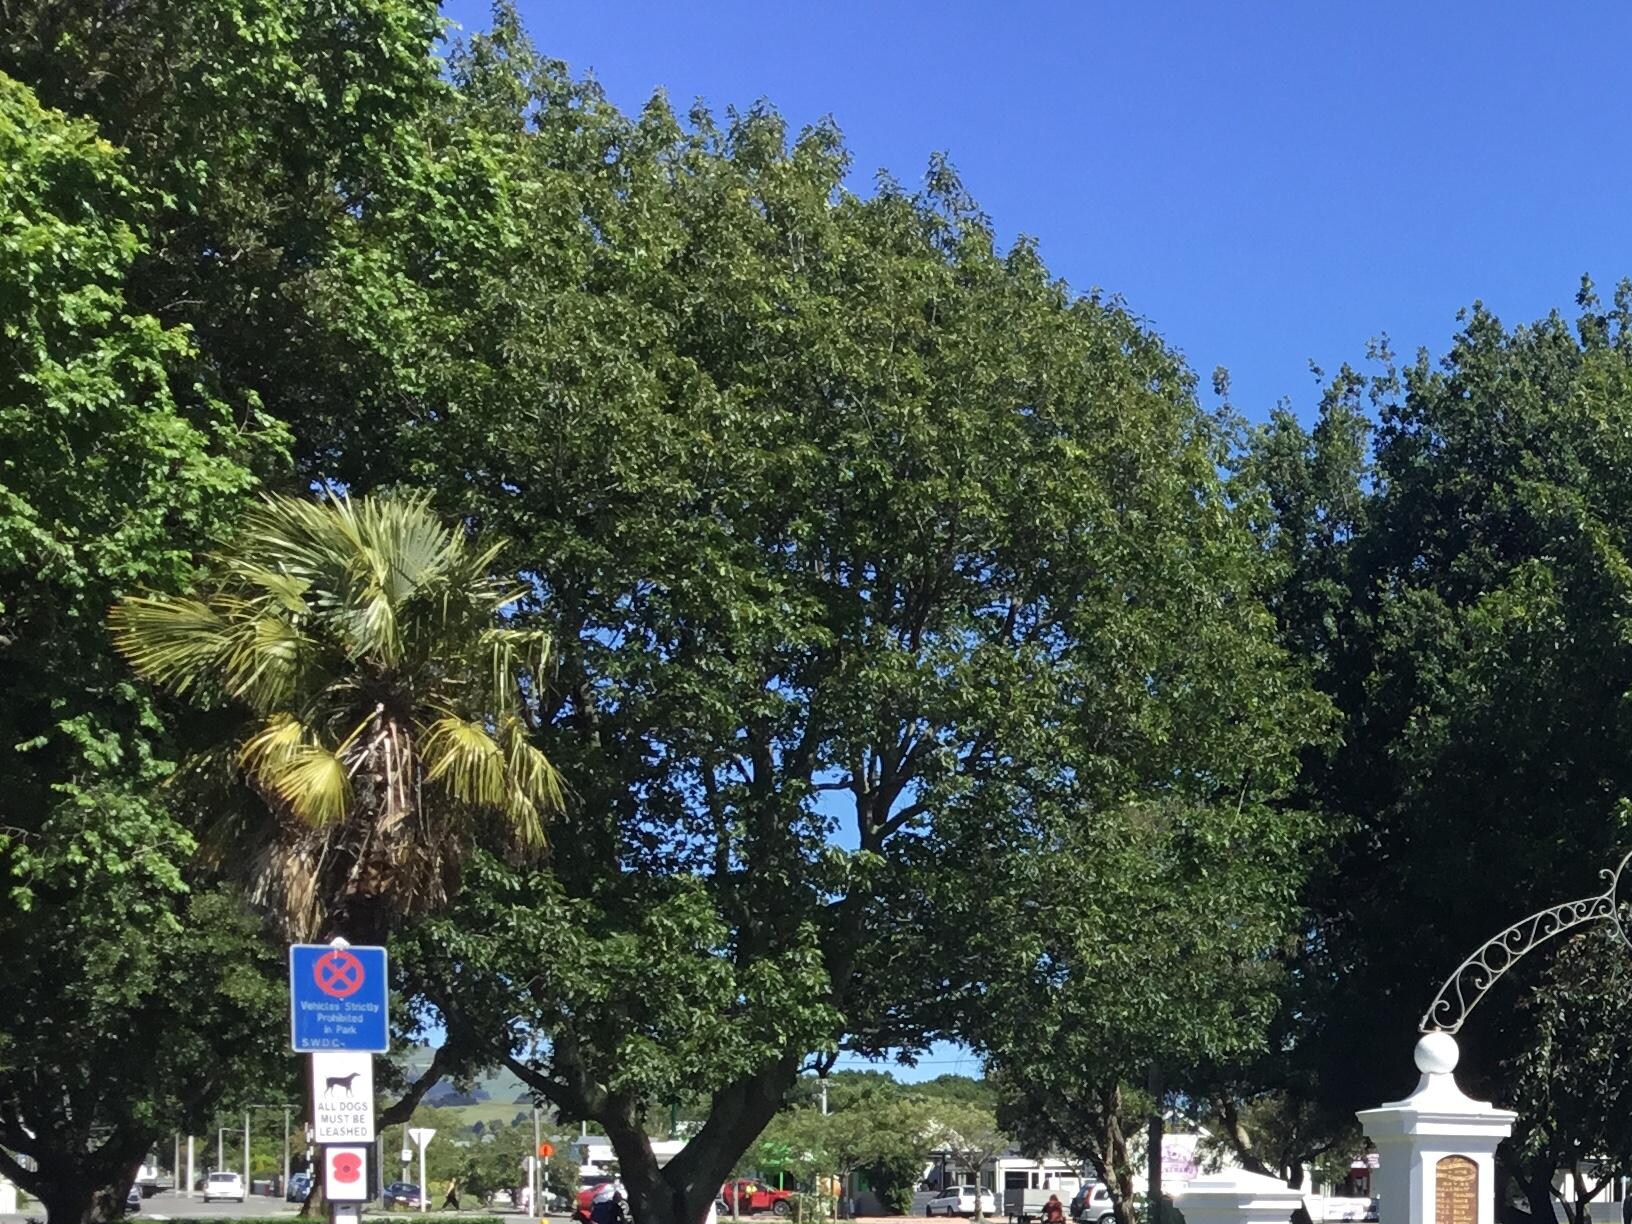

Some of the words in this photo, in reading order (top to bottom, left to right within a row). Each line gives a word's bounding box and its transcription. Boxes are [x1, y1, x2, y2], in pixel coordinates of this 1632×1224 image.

[301, 1001, 340, 1011] Vehicles
[345, 1001, 379, 1013] Strictly
[317, 1012, 364, 1023] Prohibited
[336, 1025, 357, 1034] Park
[318, 1102, 336, 1111] ALL
[339, 1102, 368, 1111] DOGS
[321, 1114, 350, 1124] MUST
[352, 1114, 365, 1124] BE
[320, 1127, 368, 1137] LEASHED
